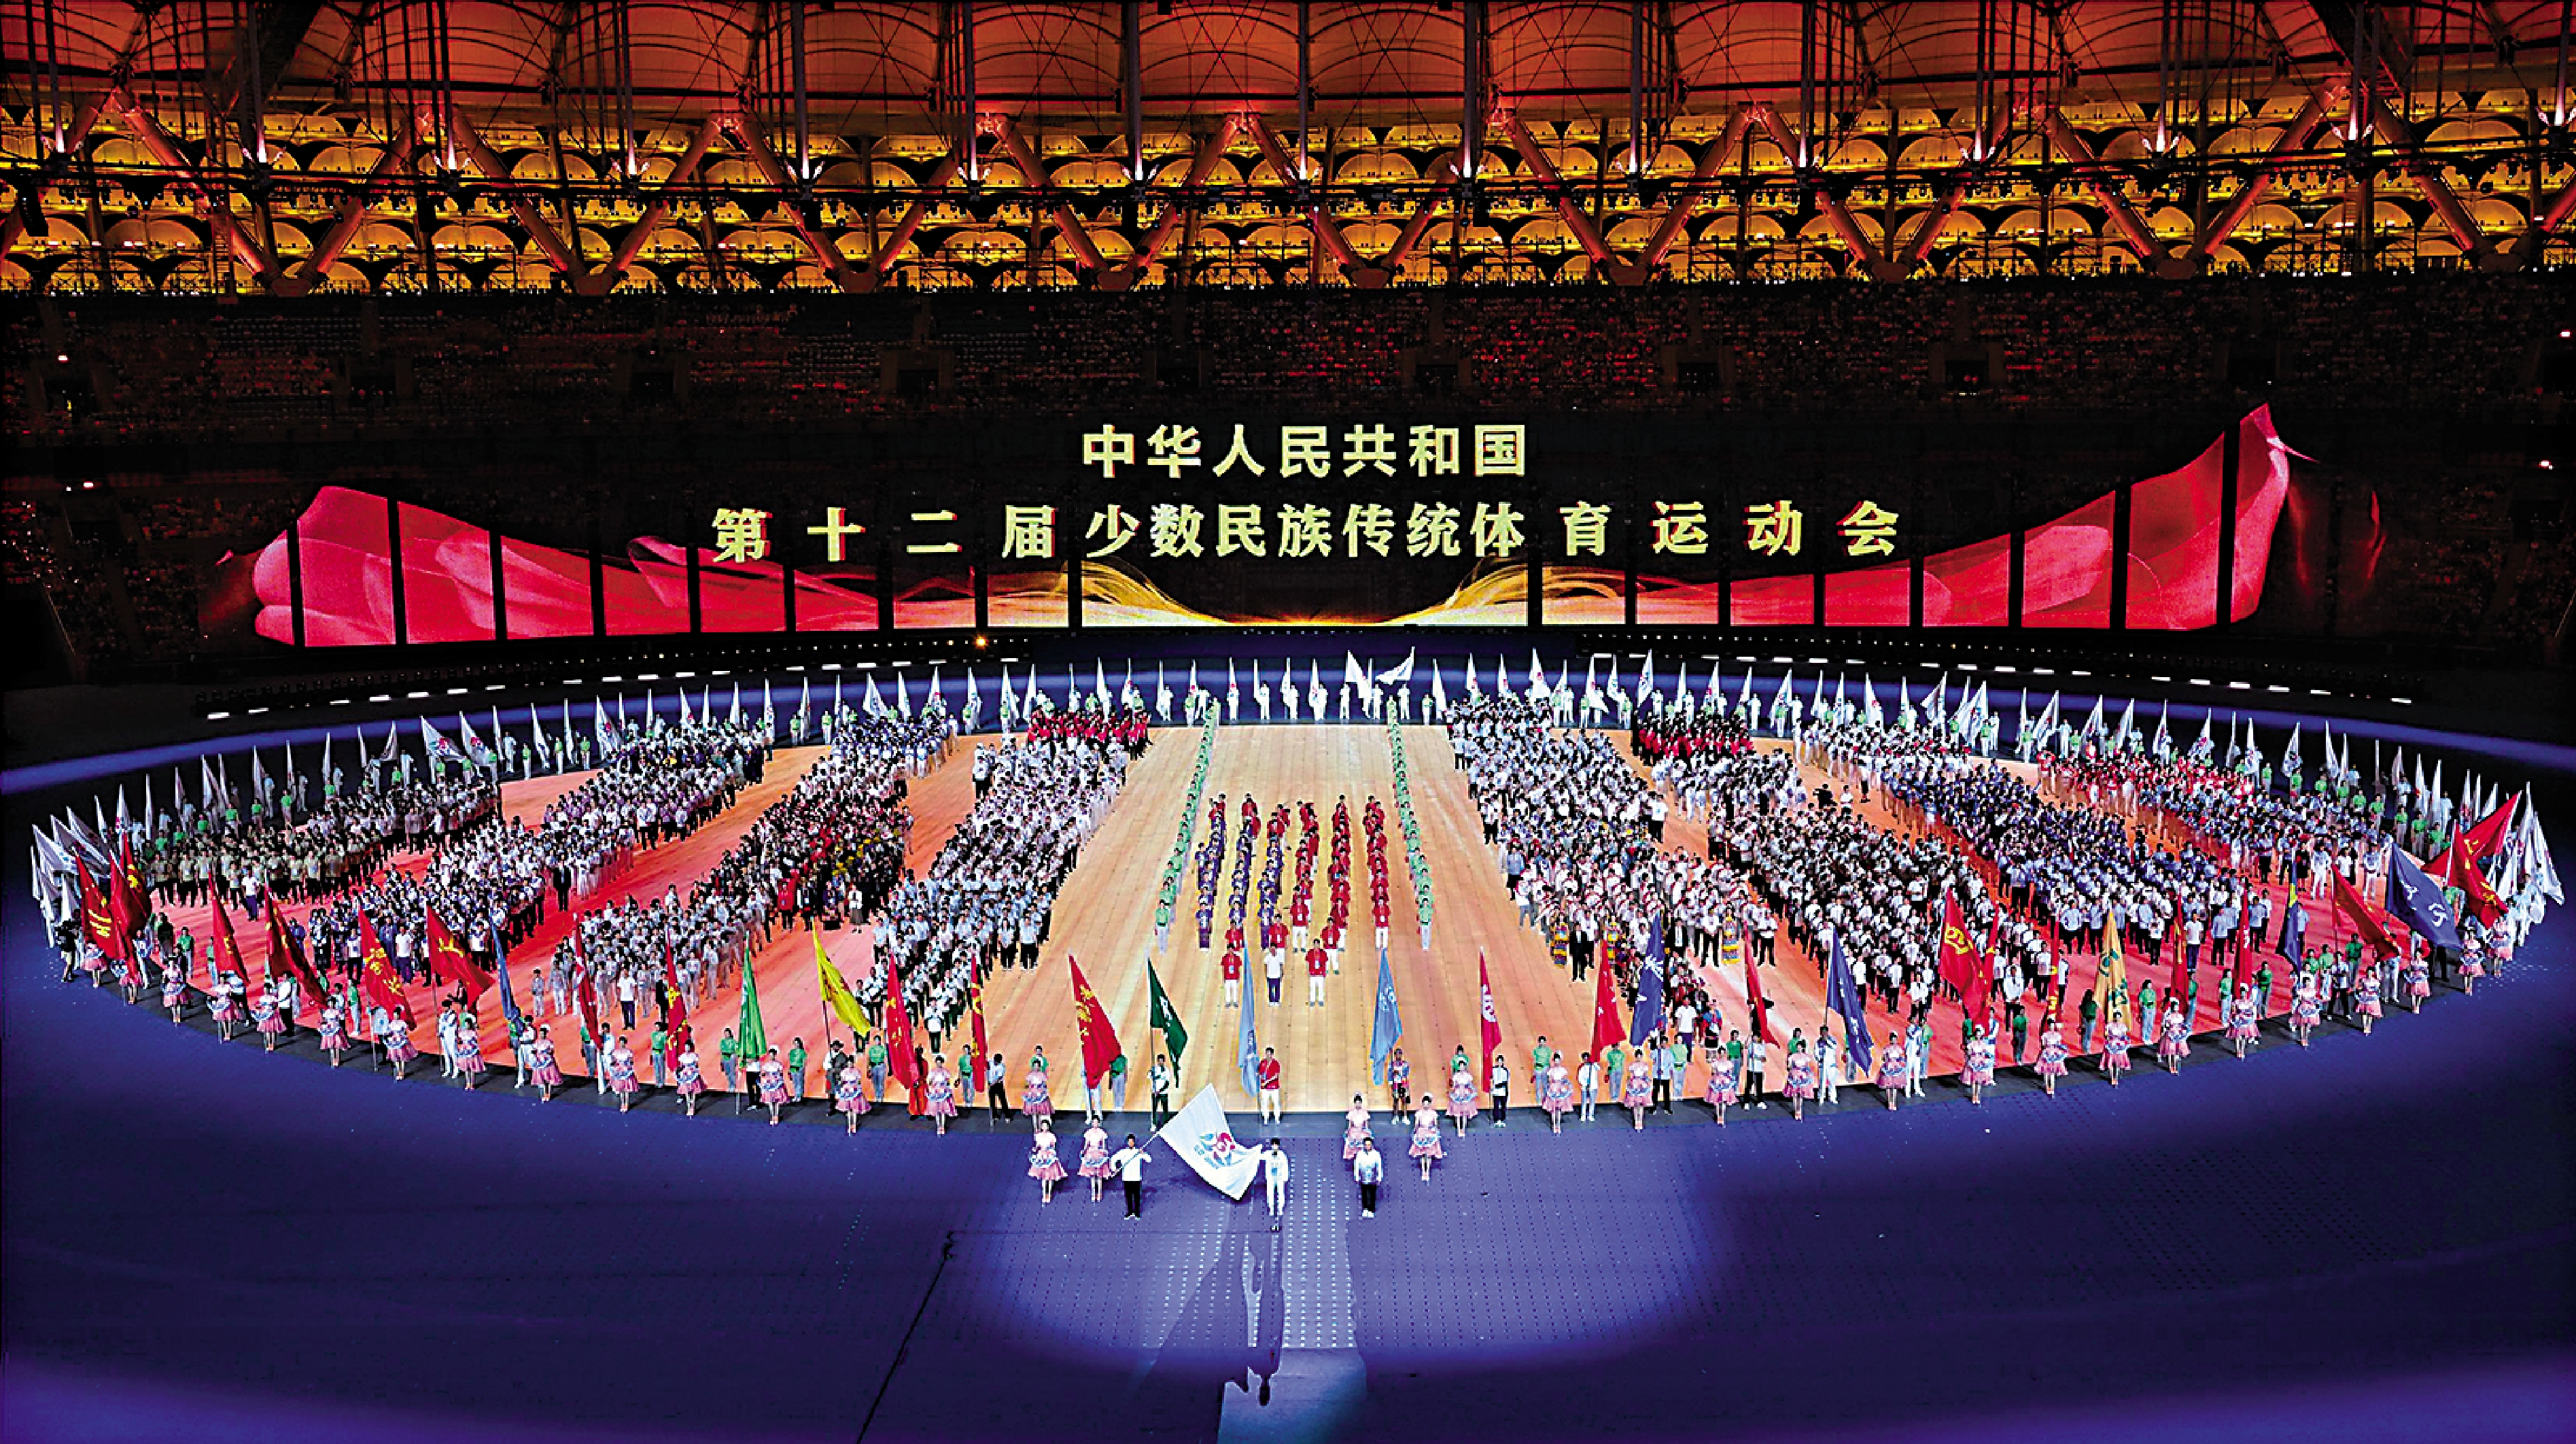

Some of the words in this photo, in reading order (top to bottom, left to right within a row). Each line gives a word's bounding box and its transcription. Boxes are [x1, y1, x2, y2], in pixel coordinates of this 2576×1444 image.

[1083, 424, 1526, 478] 中华人民共和国
[712, 500, 1902, 563] 第十二届少数民族传统体育运动会
